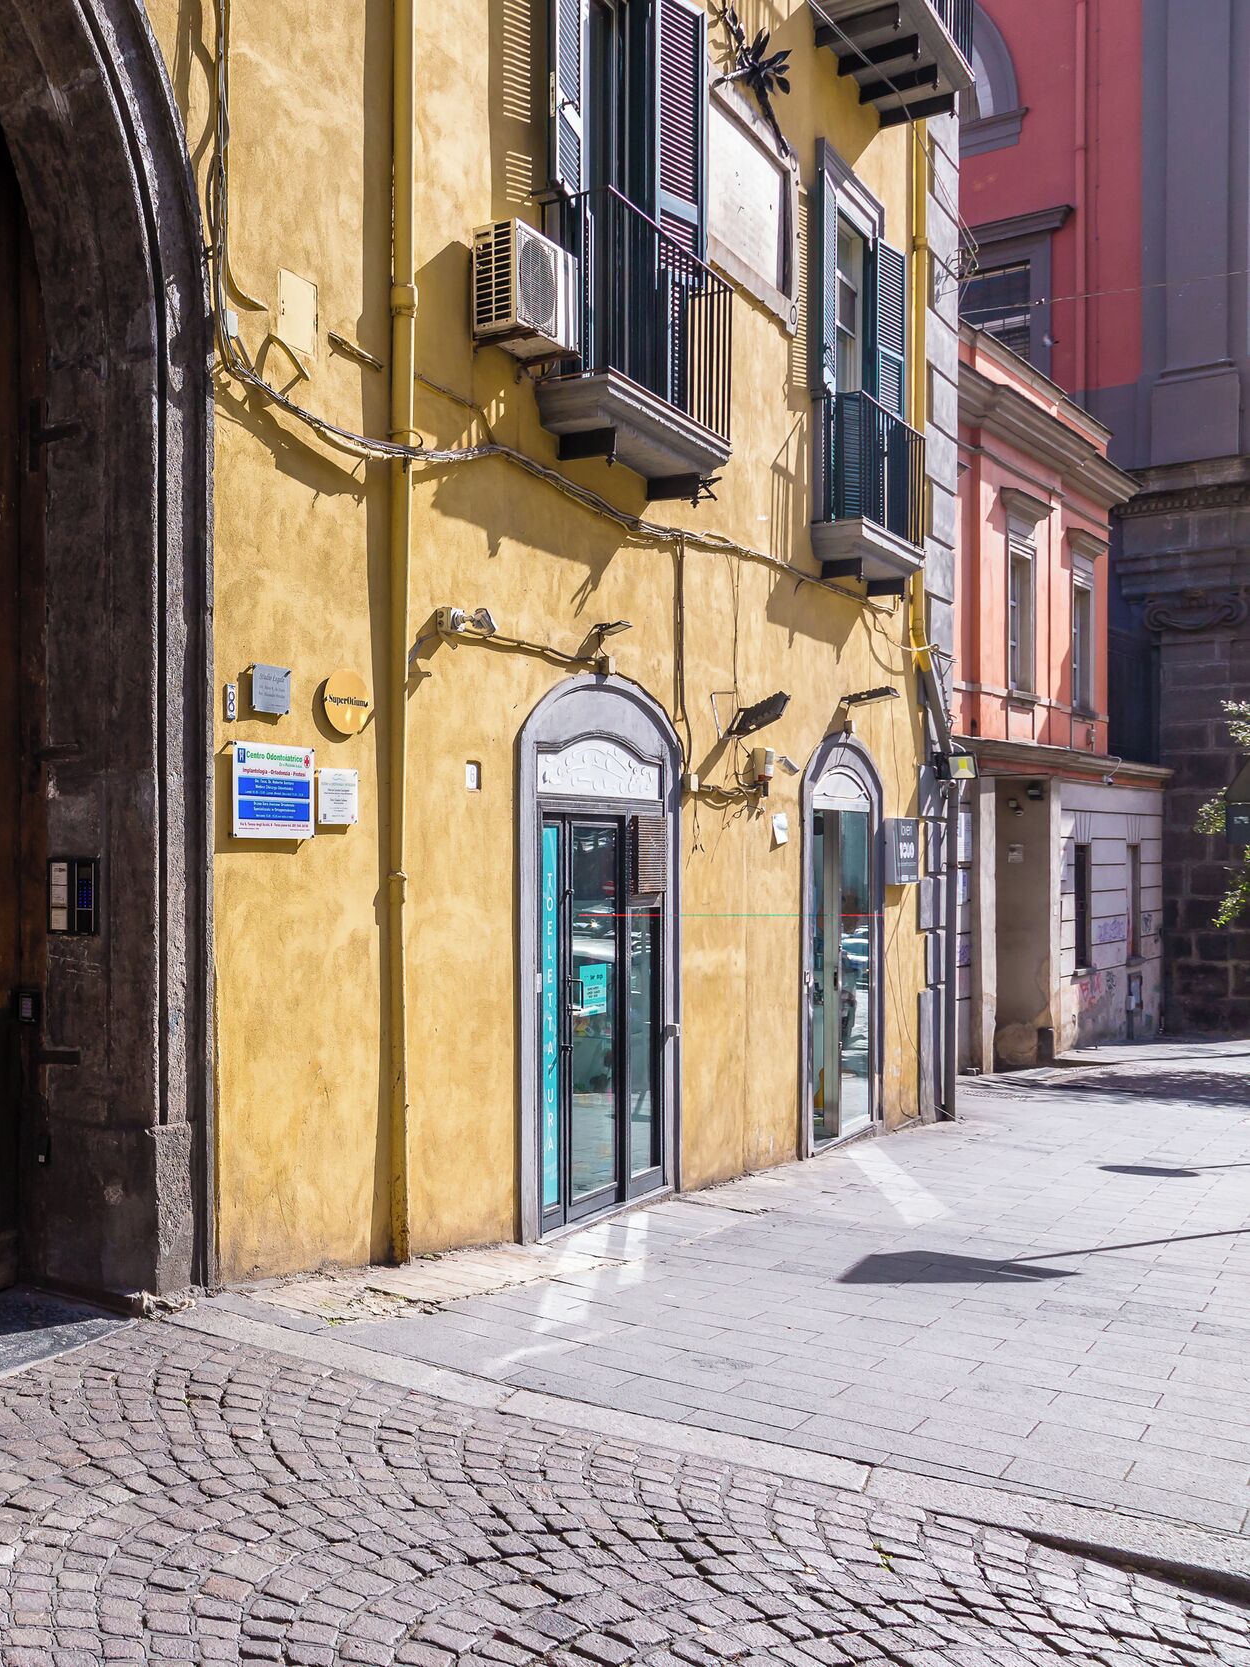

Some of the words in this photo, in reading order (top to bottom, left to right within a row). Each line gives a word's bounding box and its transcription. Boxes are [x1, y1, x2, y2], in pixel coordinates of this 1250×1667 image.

[228, 691, 235, 712] 8
[246, 750, 265, 760] Centro
[266, 752, 303, 763] Odontoiatrico
[243, 767, 268, 775] Implantologia
